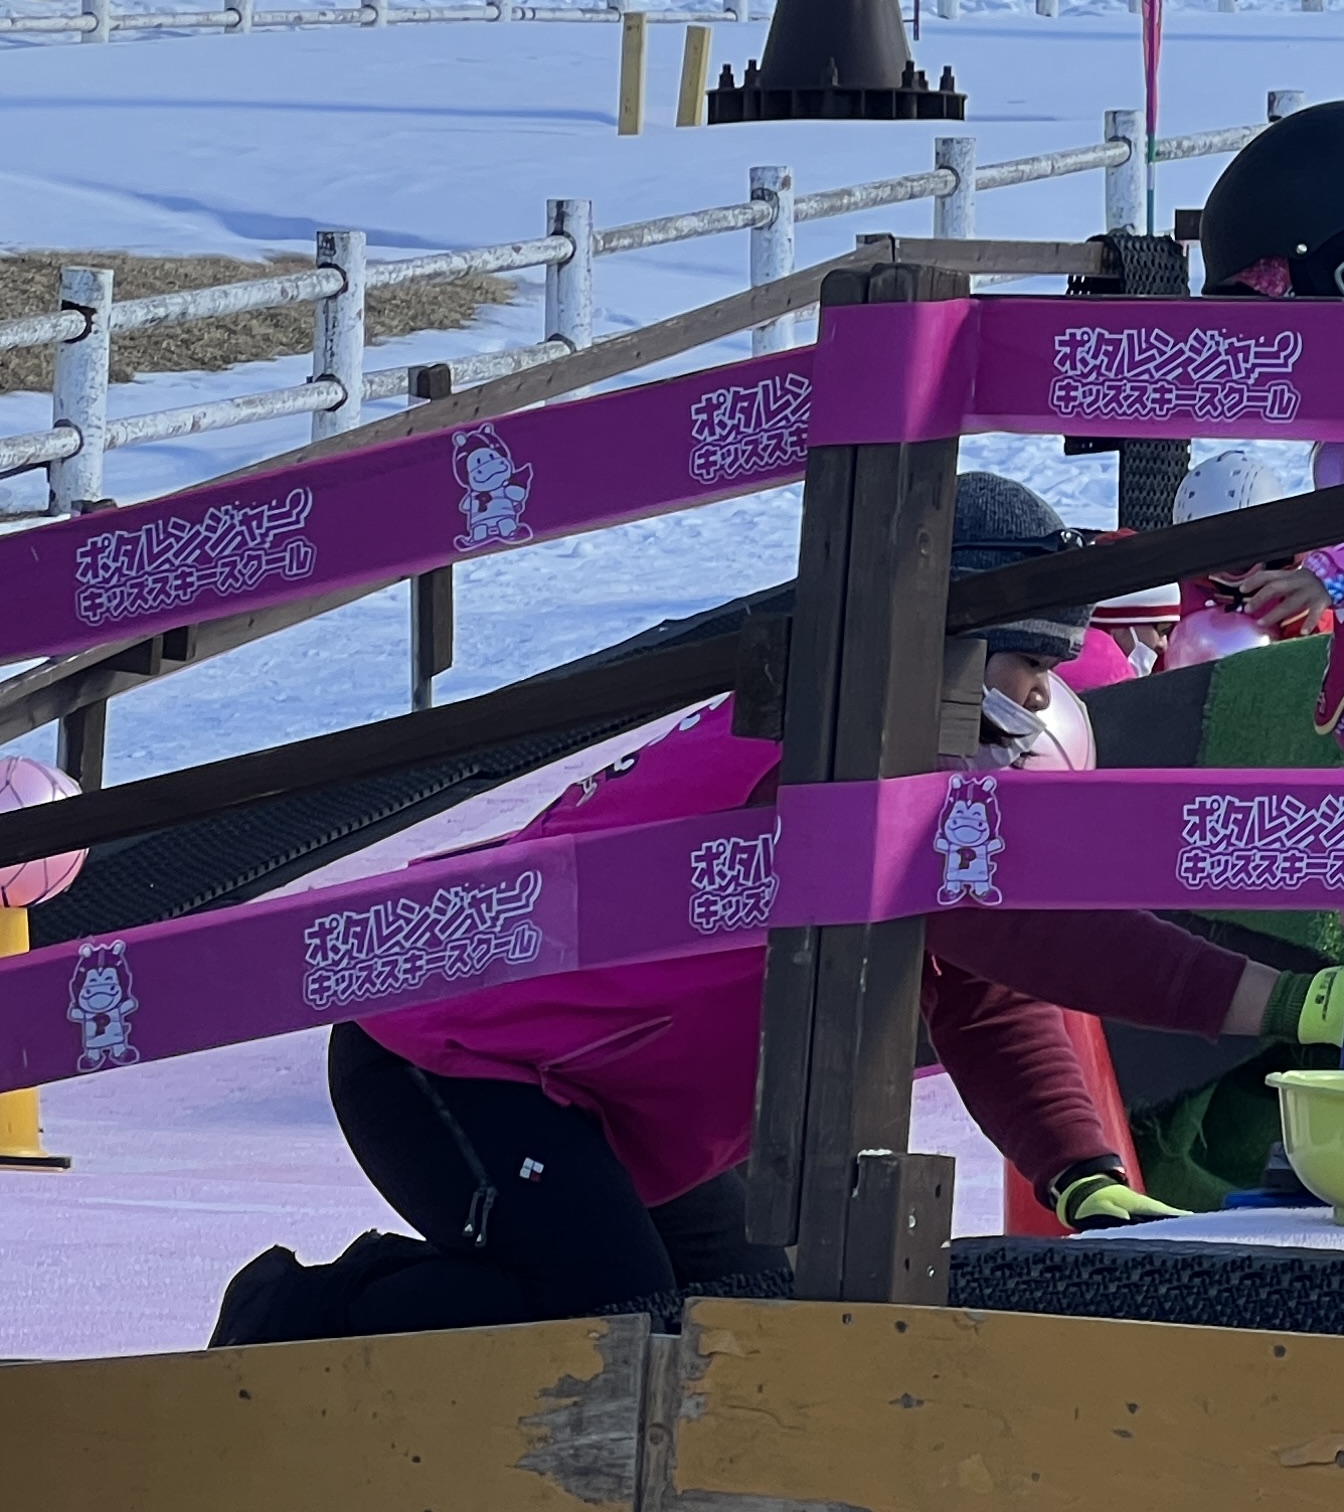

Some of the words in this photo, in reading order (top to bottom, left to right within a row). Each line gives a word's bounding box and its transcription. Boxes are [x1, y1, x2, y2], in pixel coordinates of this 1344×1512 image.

[1052, 327, 1302, 381] ポタレンジャー
[1049, 377, 1302, 422] キッズスキースクール
[76, 488, 313, 584] ポタレンジャー
[75, 539, 316, 626] キッズスキースクール
[304, 871, 542, 967] ポタレンジャー
[303, 920, 541, 1010] キッズスキースクール
